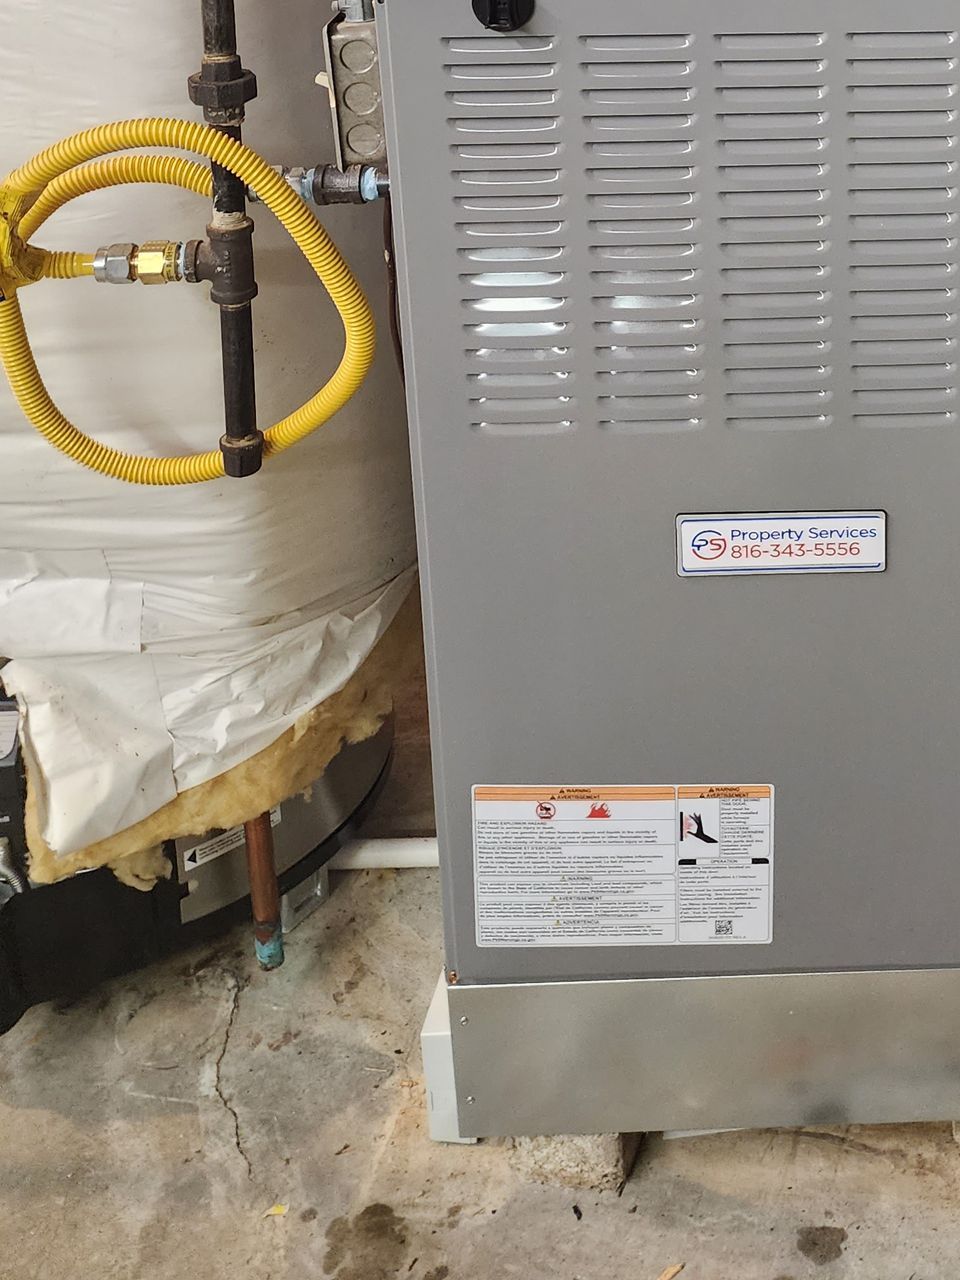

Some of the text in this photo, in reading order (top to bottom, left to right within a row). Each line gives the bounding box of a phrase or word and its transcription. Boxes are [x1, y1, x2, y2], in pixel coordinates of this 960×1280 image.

[731, 526, 877, 542] Property Services
[731, 542, 861, 559] 816-343-5556
